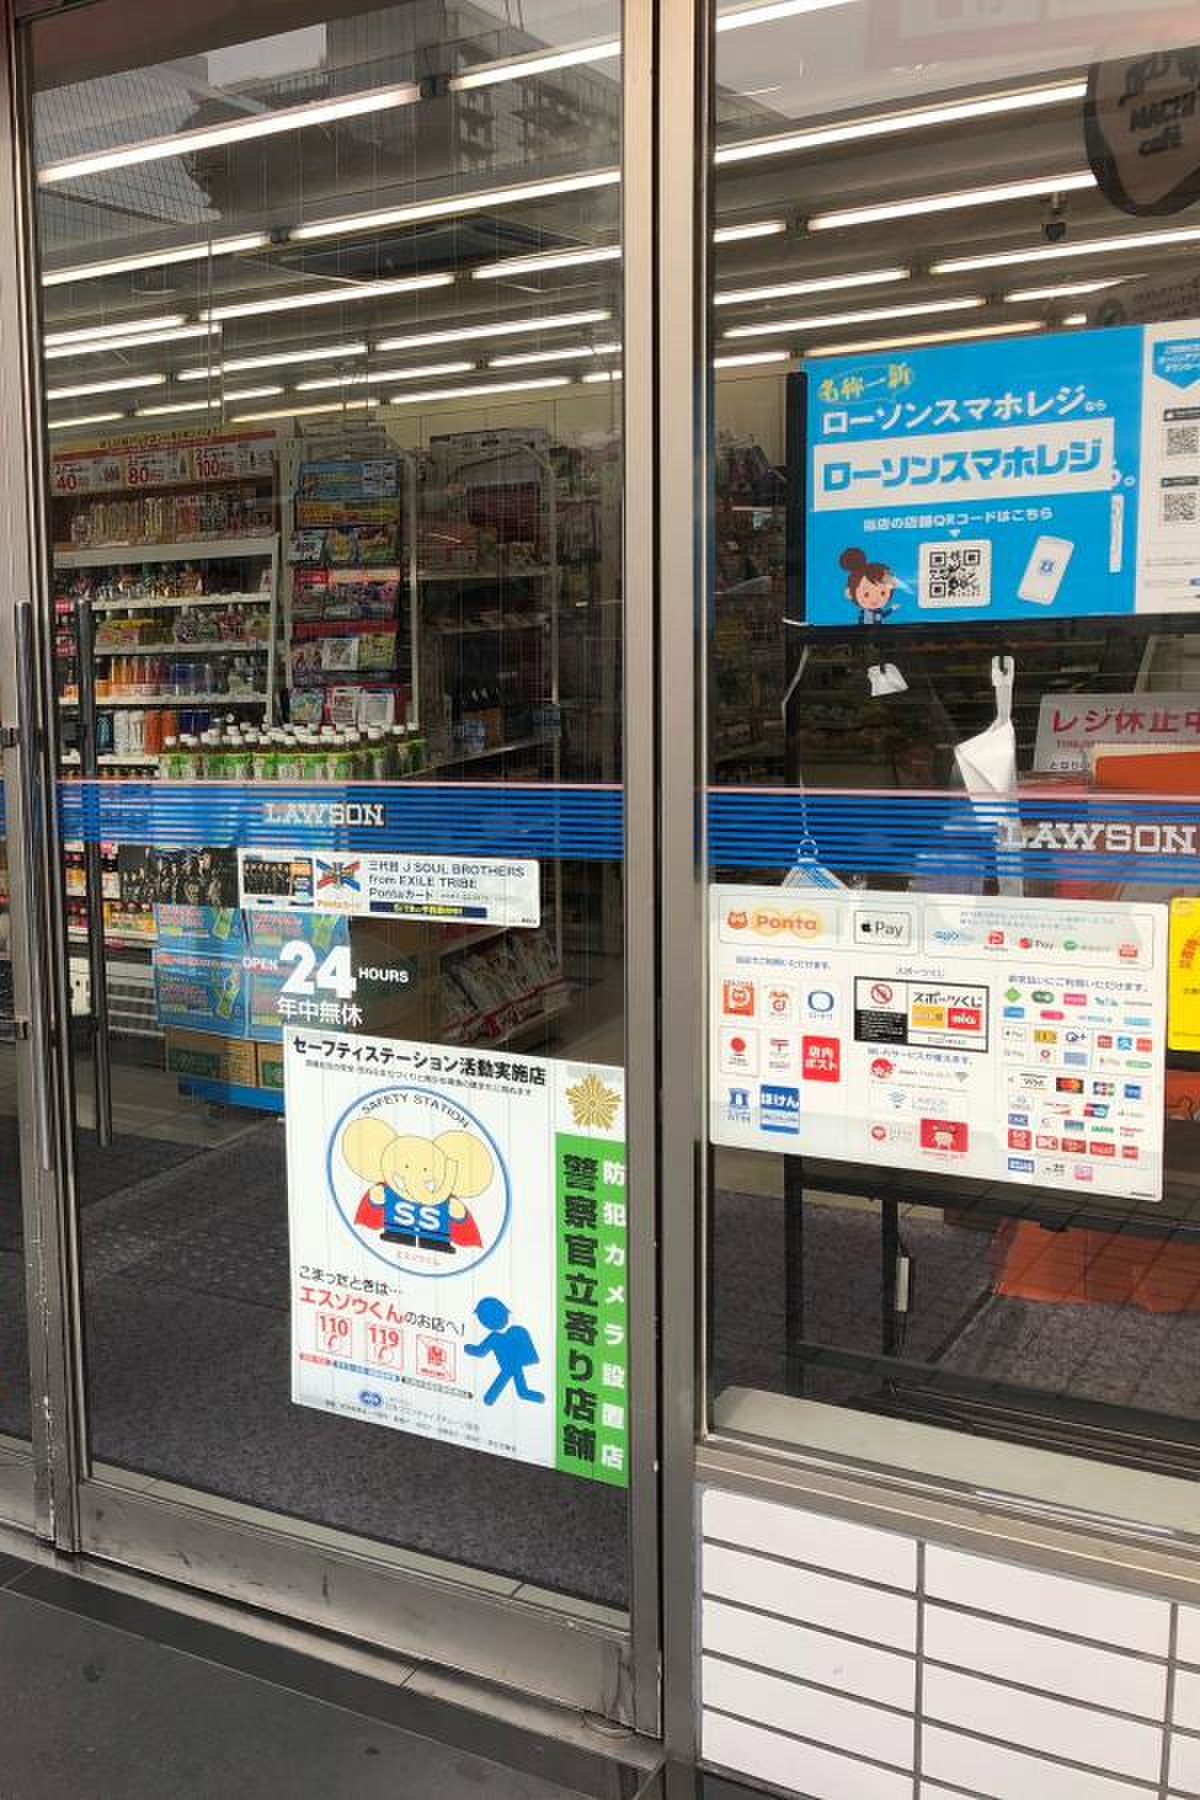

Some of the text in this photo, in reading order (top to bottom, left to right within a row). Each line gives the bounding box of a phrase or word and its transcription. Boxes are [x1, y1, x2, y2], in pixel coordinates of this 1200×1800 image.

[823, 438, 1102, 493] ローソンスマホレジ
[264, 802, 386, 827] LAWSON
[1001, 822, 1199, 856] LAWSON
[368, 872, 478, 889] from EXILE TRIBE
[413, 861, 450, 876] SOUL
[451, 863, 526, 879] BROTHERS
[755, 914, 817, 931] Ponta
[874, 920, 903, 938] Pay
[242, 939, 409, 999] OPEN 24 HOURS
[276, 997, 364, 1026] 年中無休
[912, 990, 983, 1008] スポーツくじ
[293, 1035, 548, 1087] セーフティステーション活動実施店
[360, 1092, 470, 1129] SAFETY STATION
[562, 1153, 599, 1463] 警察官立寄り店舗
[601, 1159, 627, 1471] 防犯カメラ設置店
[319, 1315, 349, 1337] 110
[368, 1326, 400, 1347] 119
